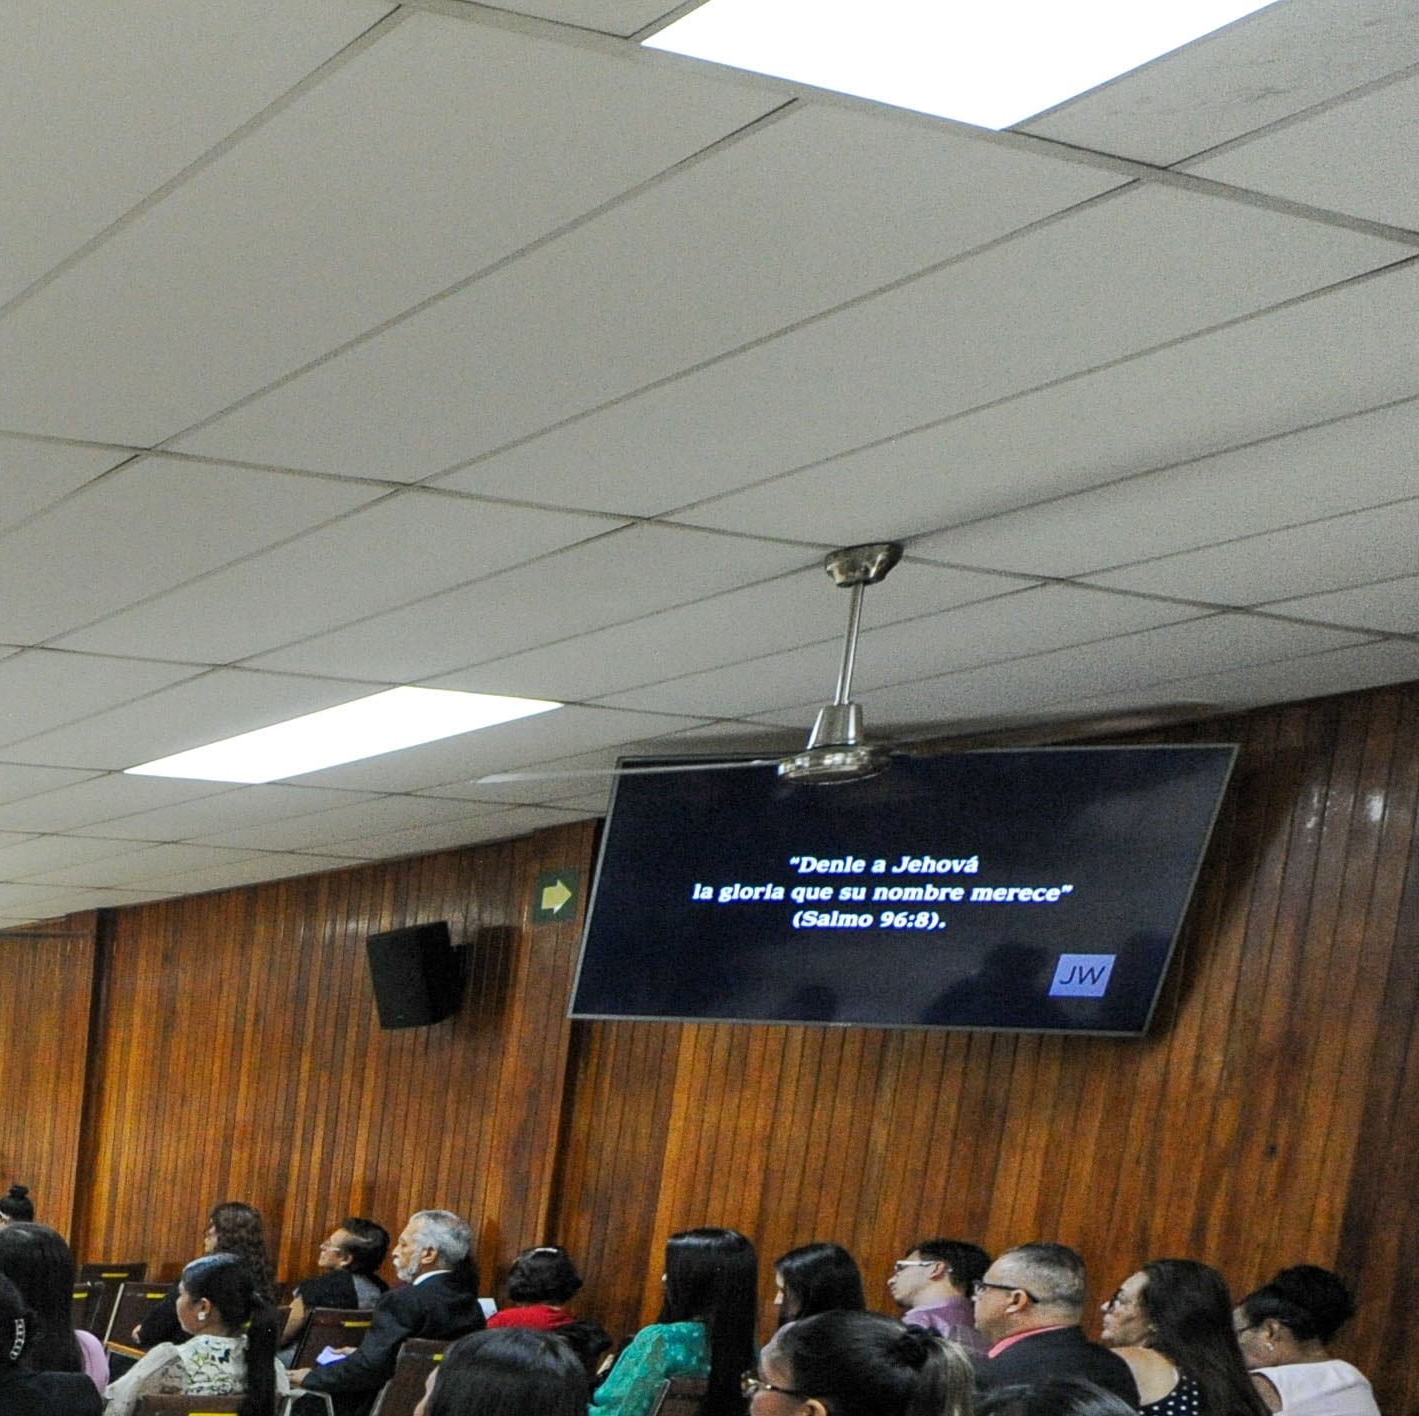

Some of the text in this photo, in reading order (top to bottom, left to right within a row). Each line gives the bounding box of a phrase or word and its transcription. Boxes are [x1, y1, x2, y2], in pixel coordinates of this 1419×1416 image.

[871, 859, 887, 874] a
[891, 855, 979, 874] Jehová
[692, 883, 714, 900] la
[717, 883, 785, 903] gloria
[791, 886, 834, 903] que
[838, 886, 866, 901] su
[872, 884, 964, 901] nombre
[792, 910, 947, 930] (Salmo 96:8).
[1060, 966, 1106, 985] JW
